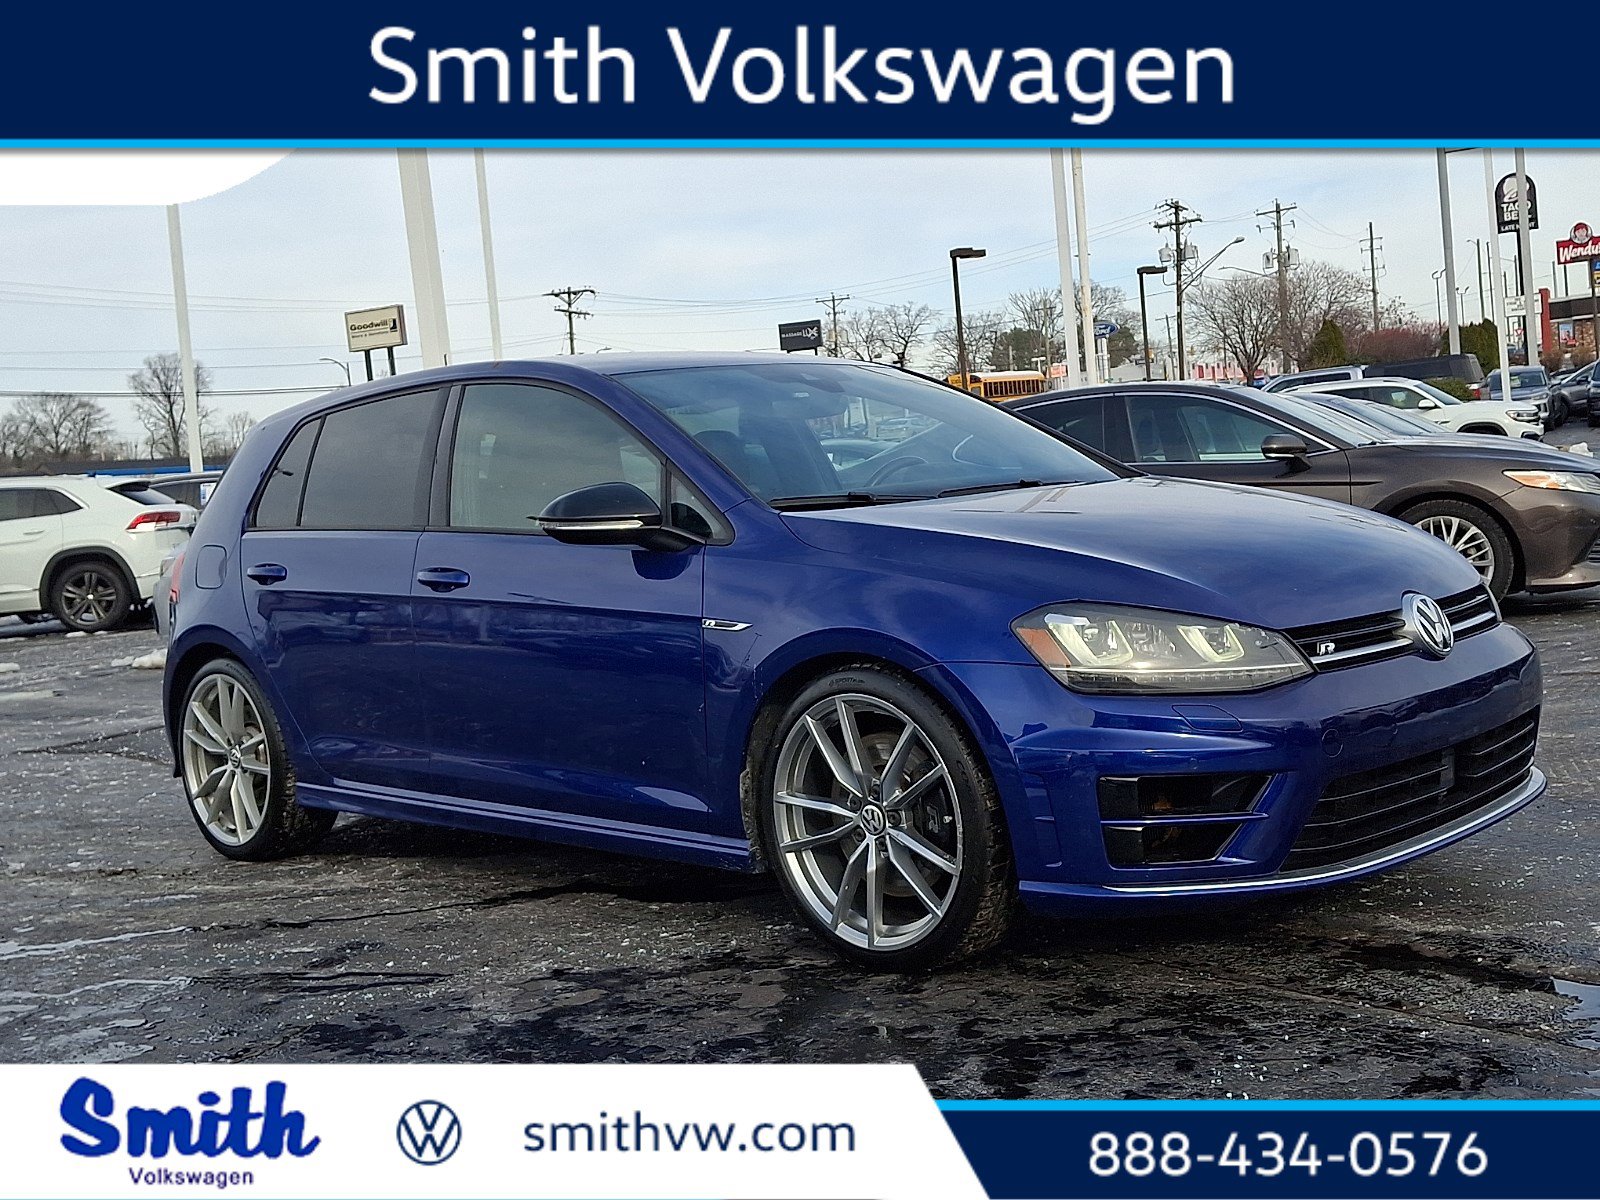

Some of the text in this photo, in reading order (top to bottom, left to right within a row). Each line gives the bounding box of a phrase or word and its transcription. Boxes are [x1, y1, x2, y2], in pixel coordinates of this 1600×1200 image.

[1504, 211, 1532, 221] BE
[1559, 241, 1600, 262] Wendy
[350, 319, 388, 331] Goodwill
[1317, 640, 1336, 656] R
